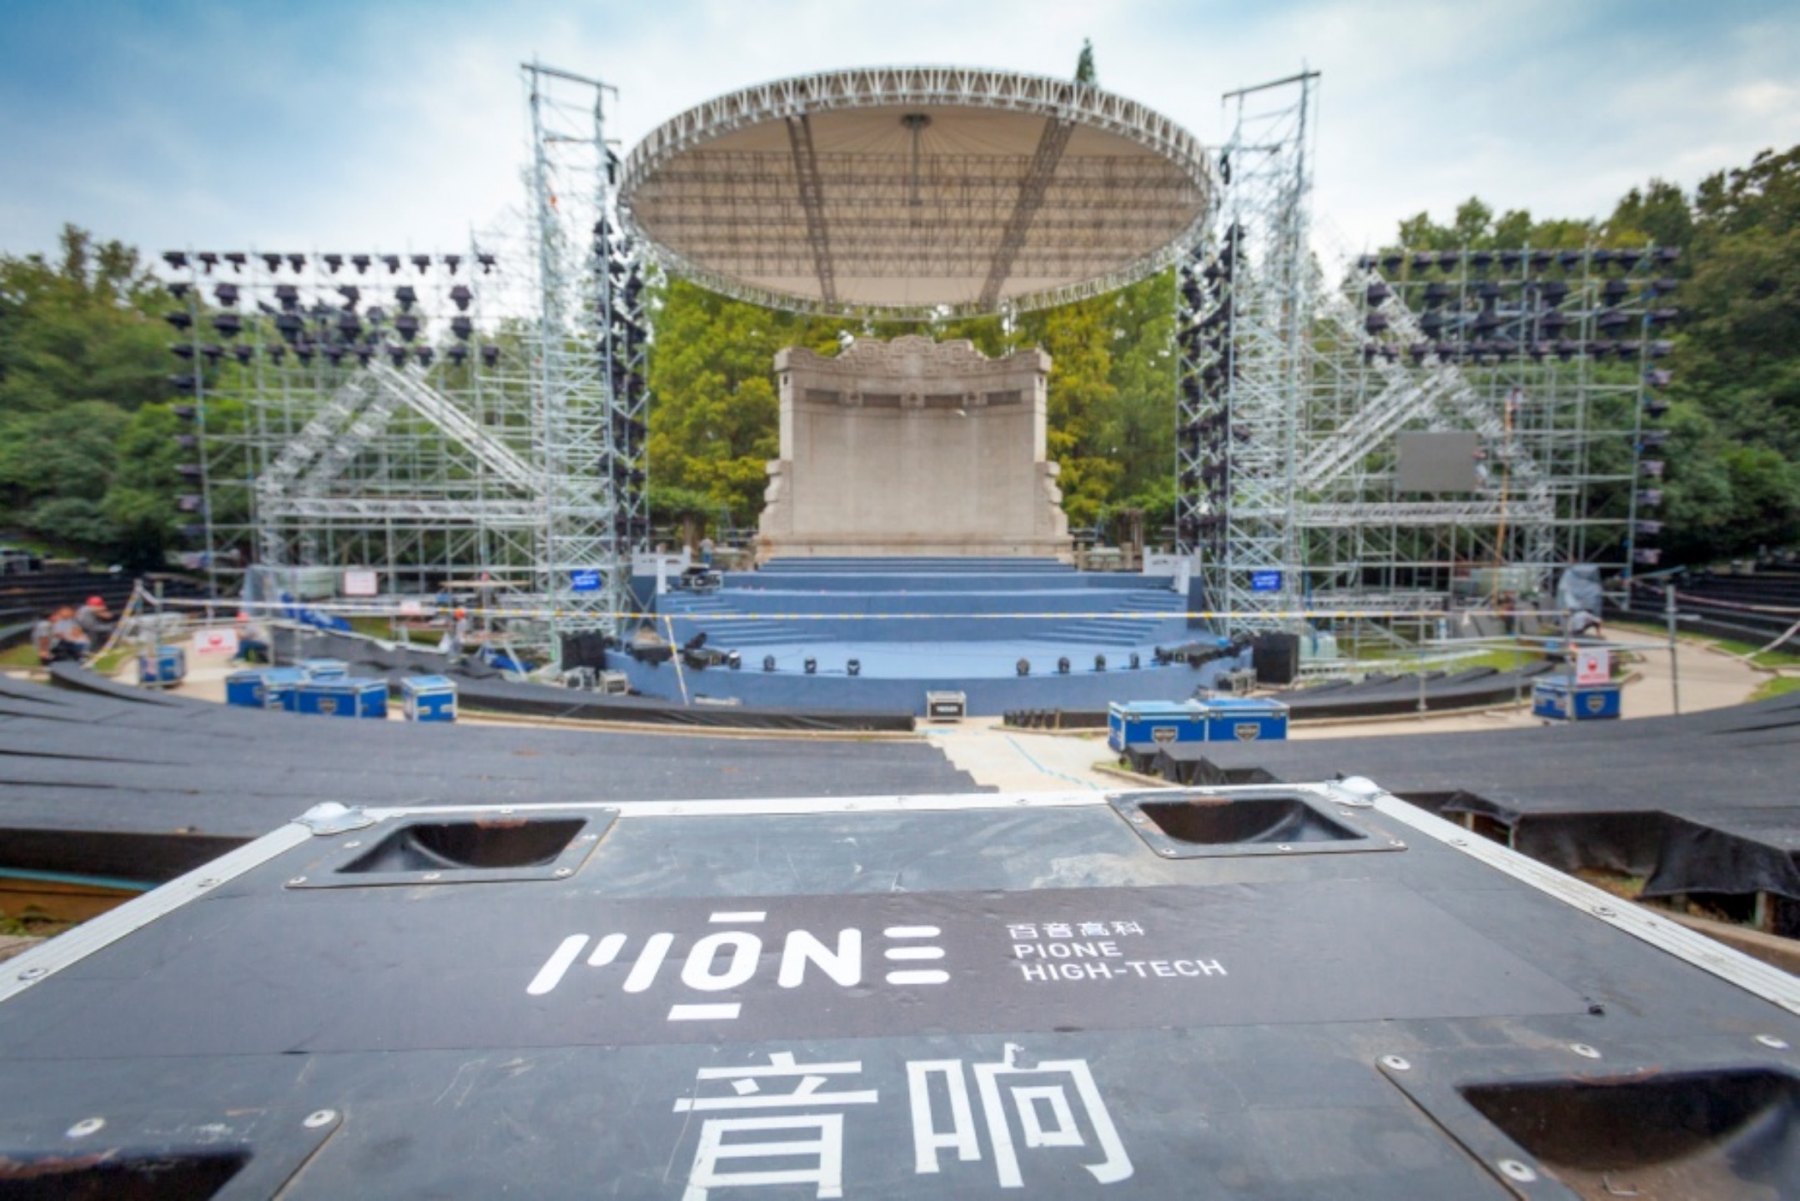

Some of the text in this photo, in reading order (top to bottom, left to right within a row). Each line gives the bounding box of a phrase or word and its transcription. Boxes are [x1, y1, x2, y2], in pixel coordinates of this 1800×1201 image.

[1006, 921, 1145, 939] 百音高科
[1013, 941, 1123, 959] PIONE
[1021, 959, 1228, 981] HIGH-TECH
[673, 1042, 1133, 1201] 音响
